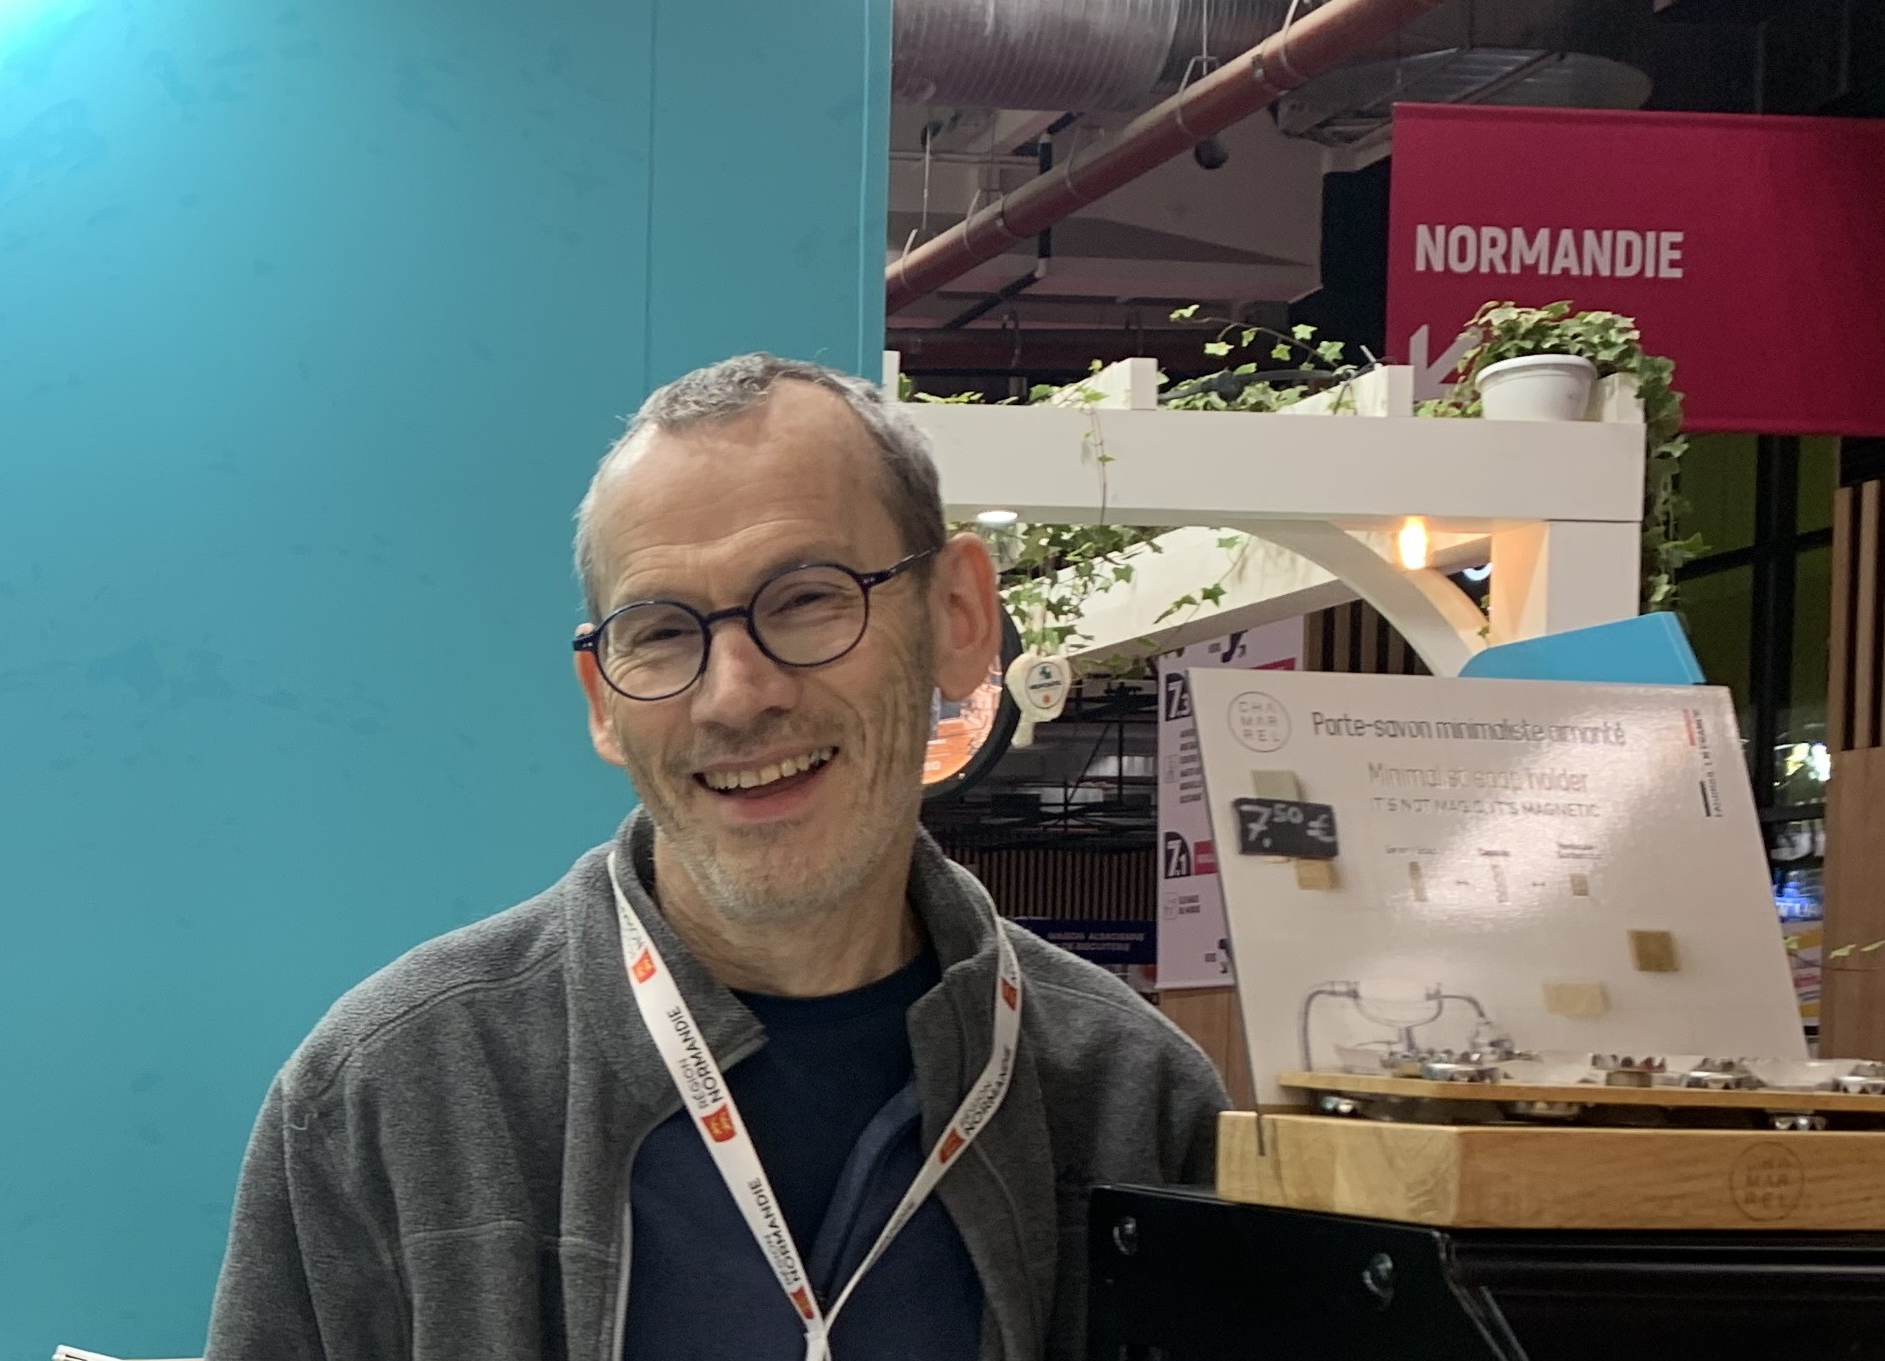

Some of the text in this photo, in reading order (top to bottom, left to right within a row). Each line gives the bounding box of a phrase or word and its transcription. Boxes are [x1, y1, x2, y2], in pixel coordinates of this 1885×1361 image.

[1415, 224, 1684, 278] NORMANDIE
[1312, 711, 1431, 739] Porte-savon
[666, 1006, 725, 1104] NORMANDIE
[747, 1176, 801, 1283] NORMANDIE
